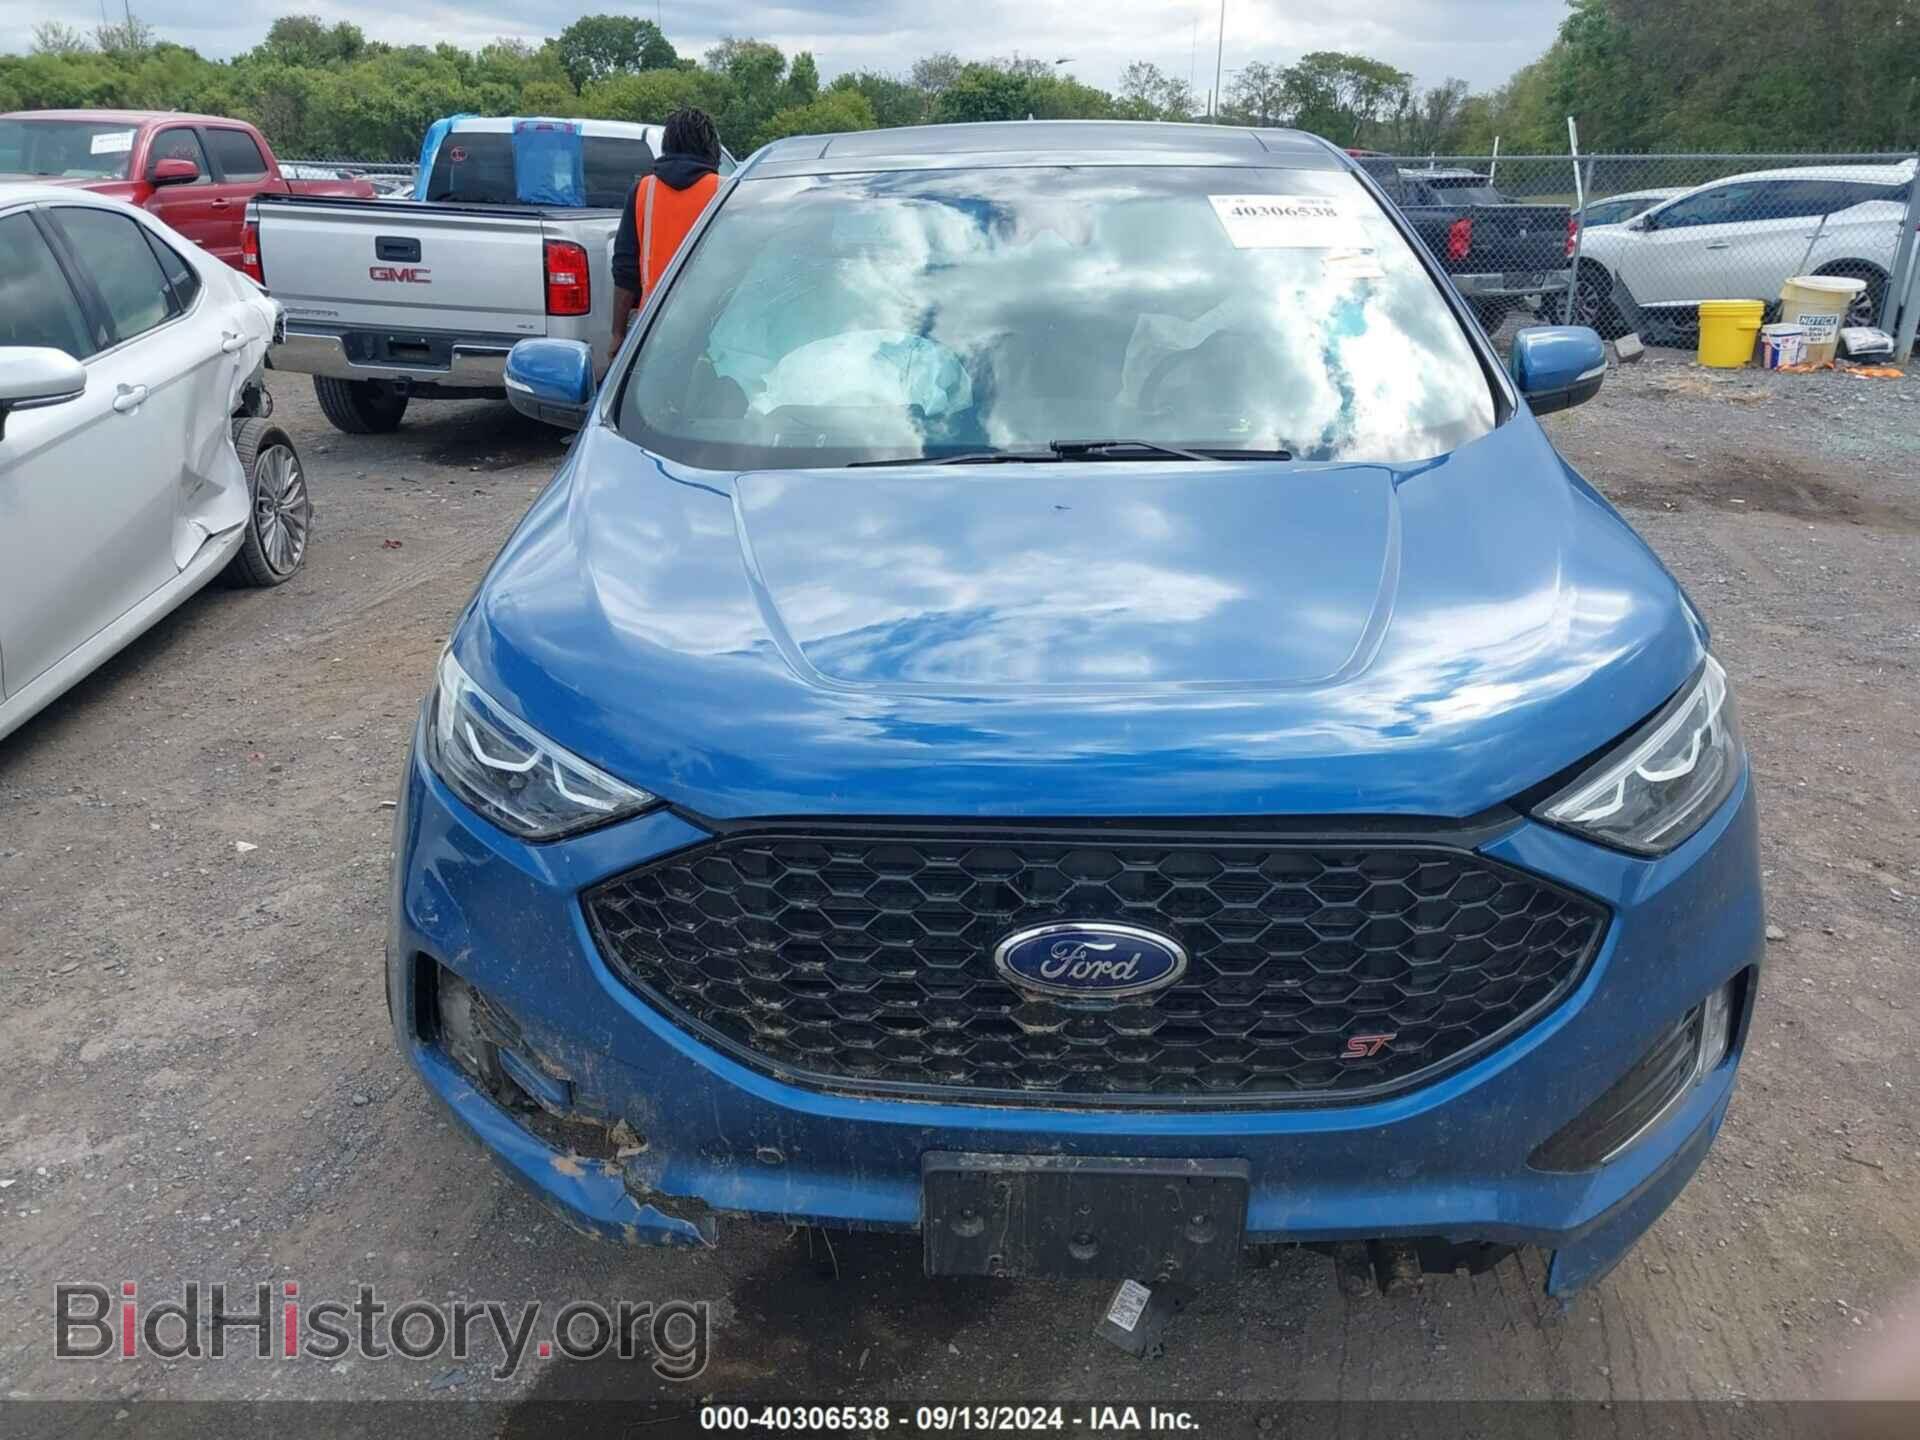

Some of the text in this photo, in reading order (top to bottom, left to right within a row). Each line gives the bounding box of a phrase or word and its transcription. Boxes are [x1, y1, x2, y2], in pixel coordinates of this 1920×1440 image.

[1231, 206, 1338, 217] 40306538
[369, 266, 432, 284] GMC
[1800, 316, 1837, 326] NOTICE
[1040, 940, 1141, 979] Ford
[1340, 1033, 1397, 1058] ST
